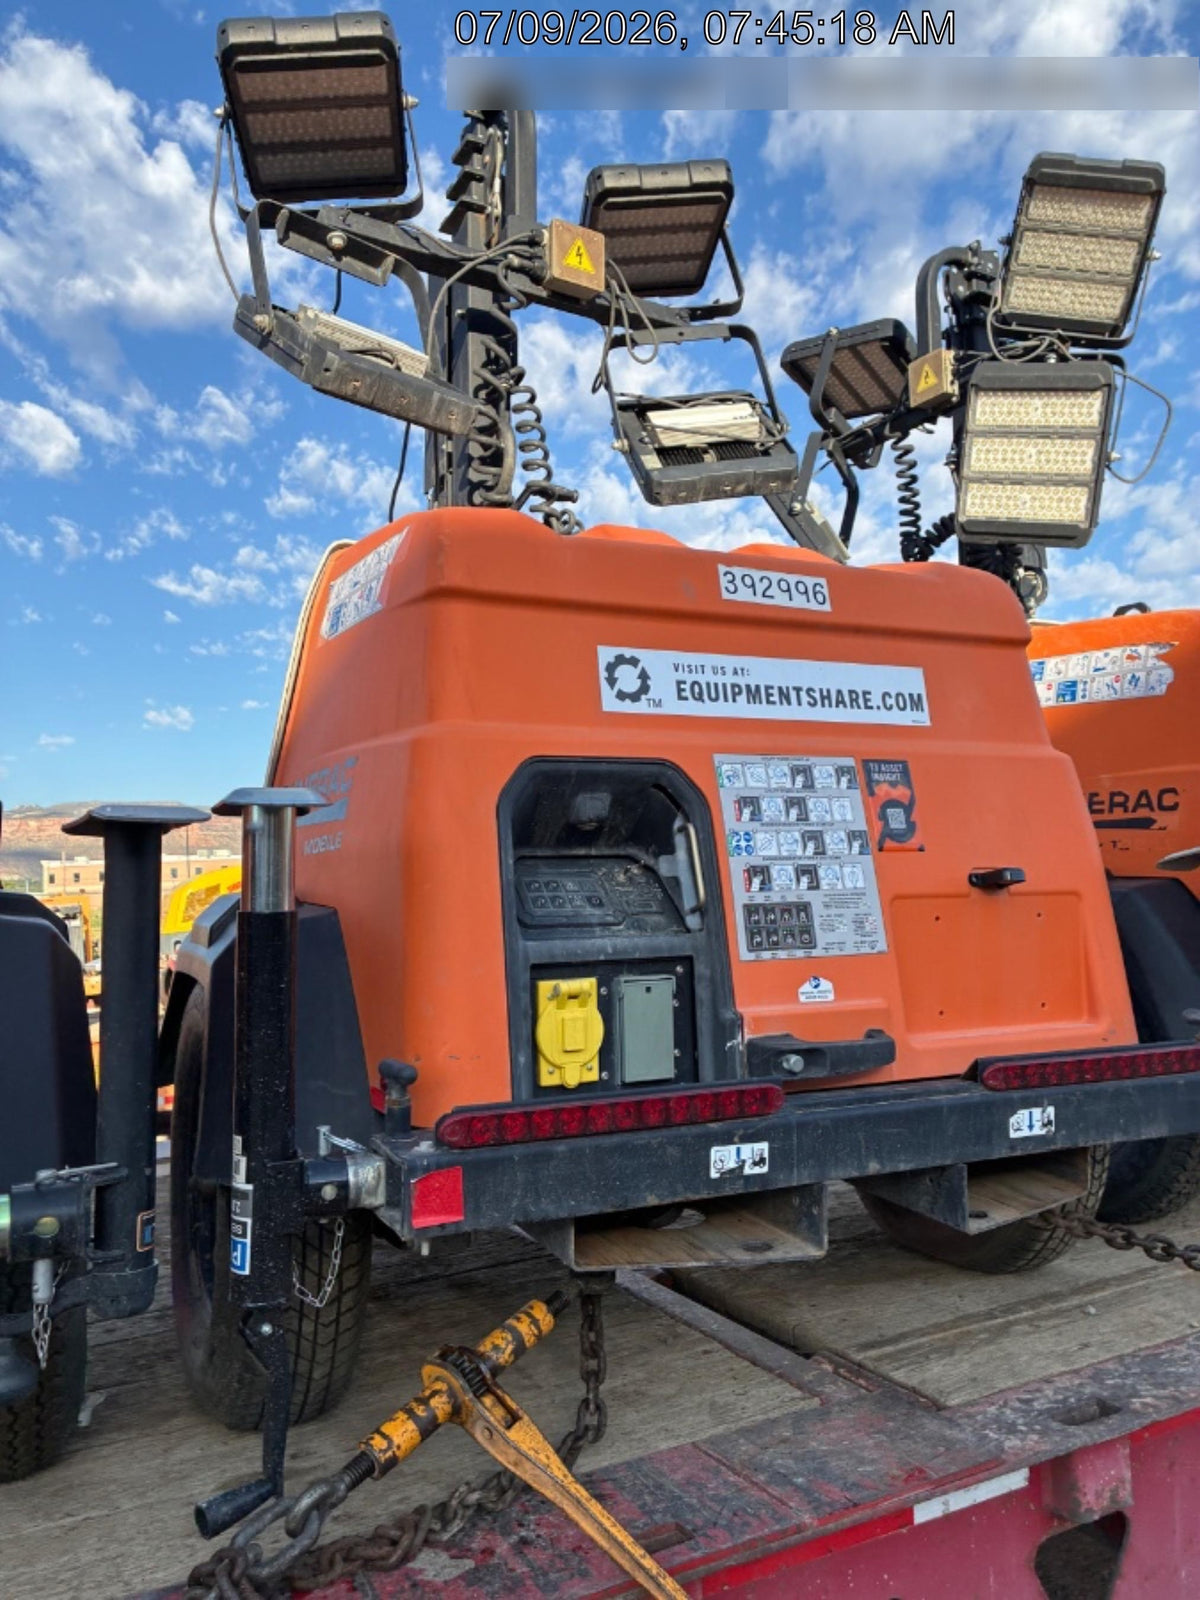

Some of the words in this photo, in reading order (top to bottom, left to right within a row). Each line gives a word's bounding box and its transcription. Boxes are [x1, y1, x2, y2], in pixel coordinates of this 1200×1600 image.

[723, 570, 827, 606] 392996
[673, 662, 706, 675] VISIT
[711, 665, 727, 677] US
[732, 666, 750, 678] AT:
[645, 697, 663, 709] TM
[675, 679, 925, 713] EQUIPMENTSHARE.COM
[1087, 786, 1180, 815] ERAC
